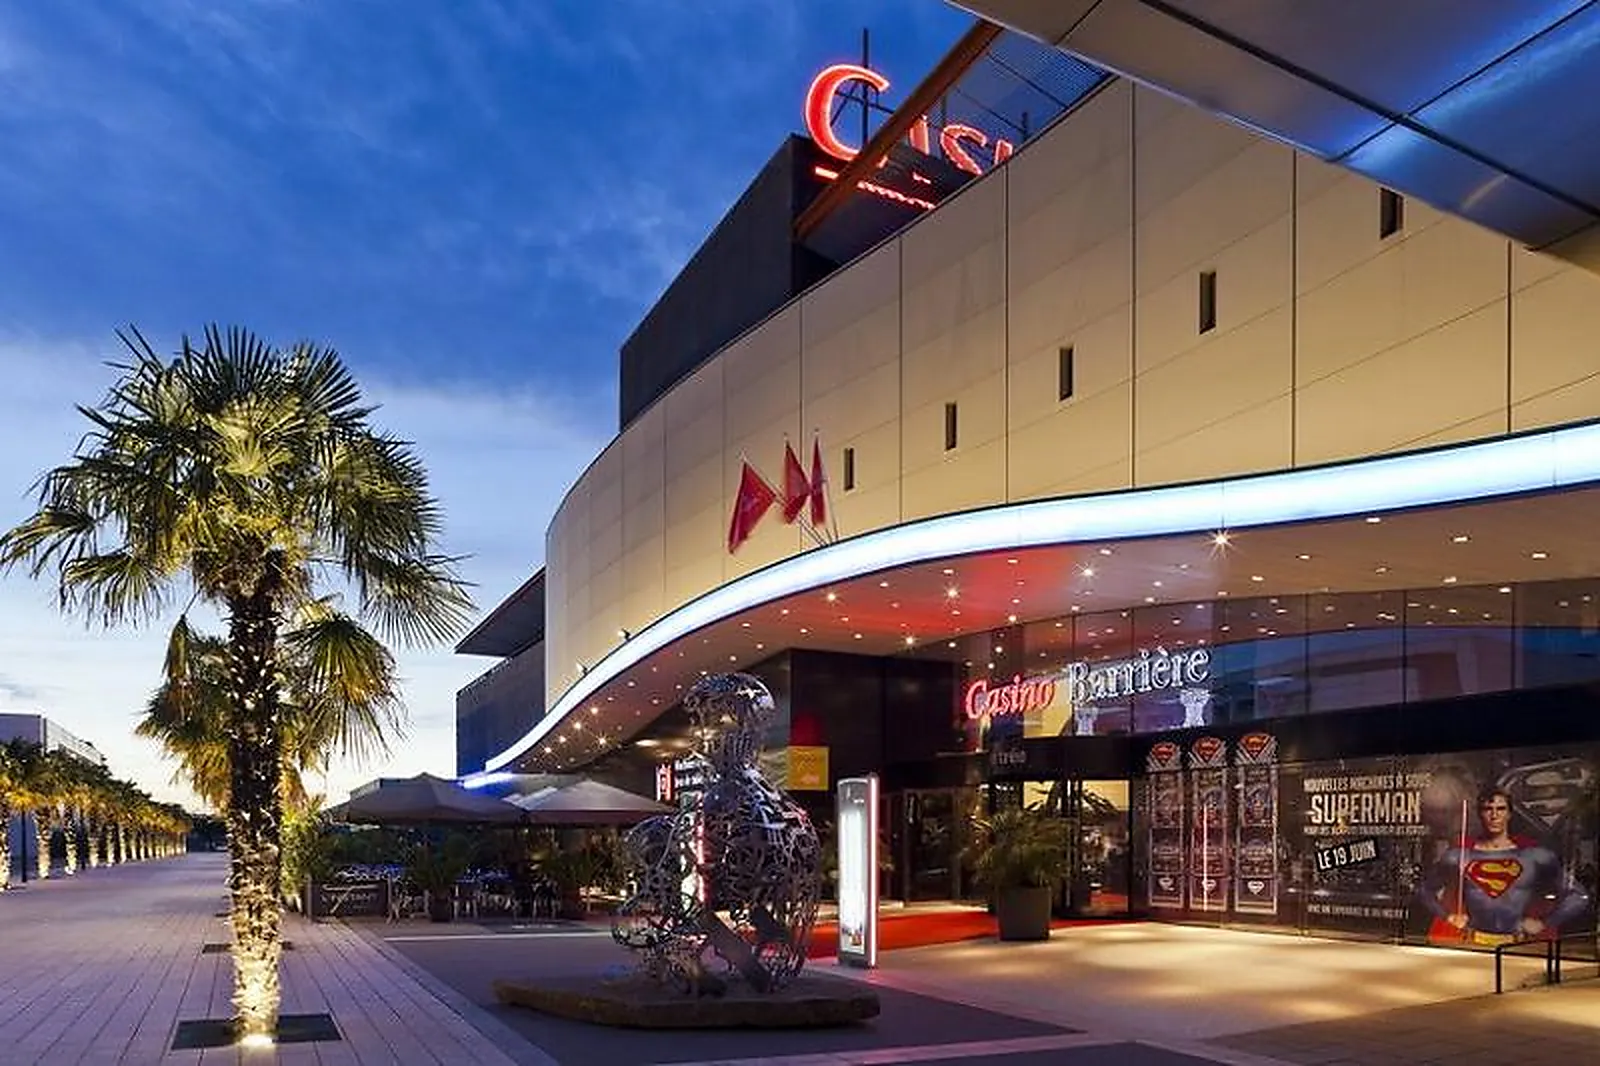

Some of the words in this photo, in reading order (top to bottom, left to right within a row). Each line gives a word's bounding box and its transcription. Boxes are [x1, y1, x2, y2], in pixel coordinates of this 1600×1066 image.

[965, 674, 1059, 719] Casino
[1067, 645, 1209, 704] Barrière
[1311, 791, 1420, 824] SUPERMAN
[1317, 849, 1333, 870] LE
[1349, 839, 1376, 863] JUIN
